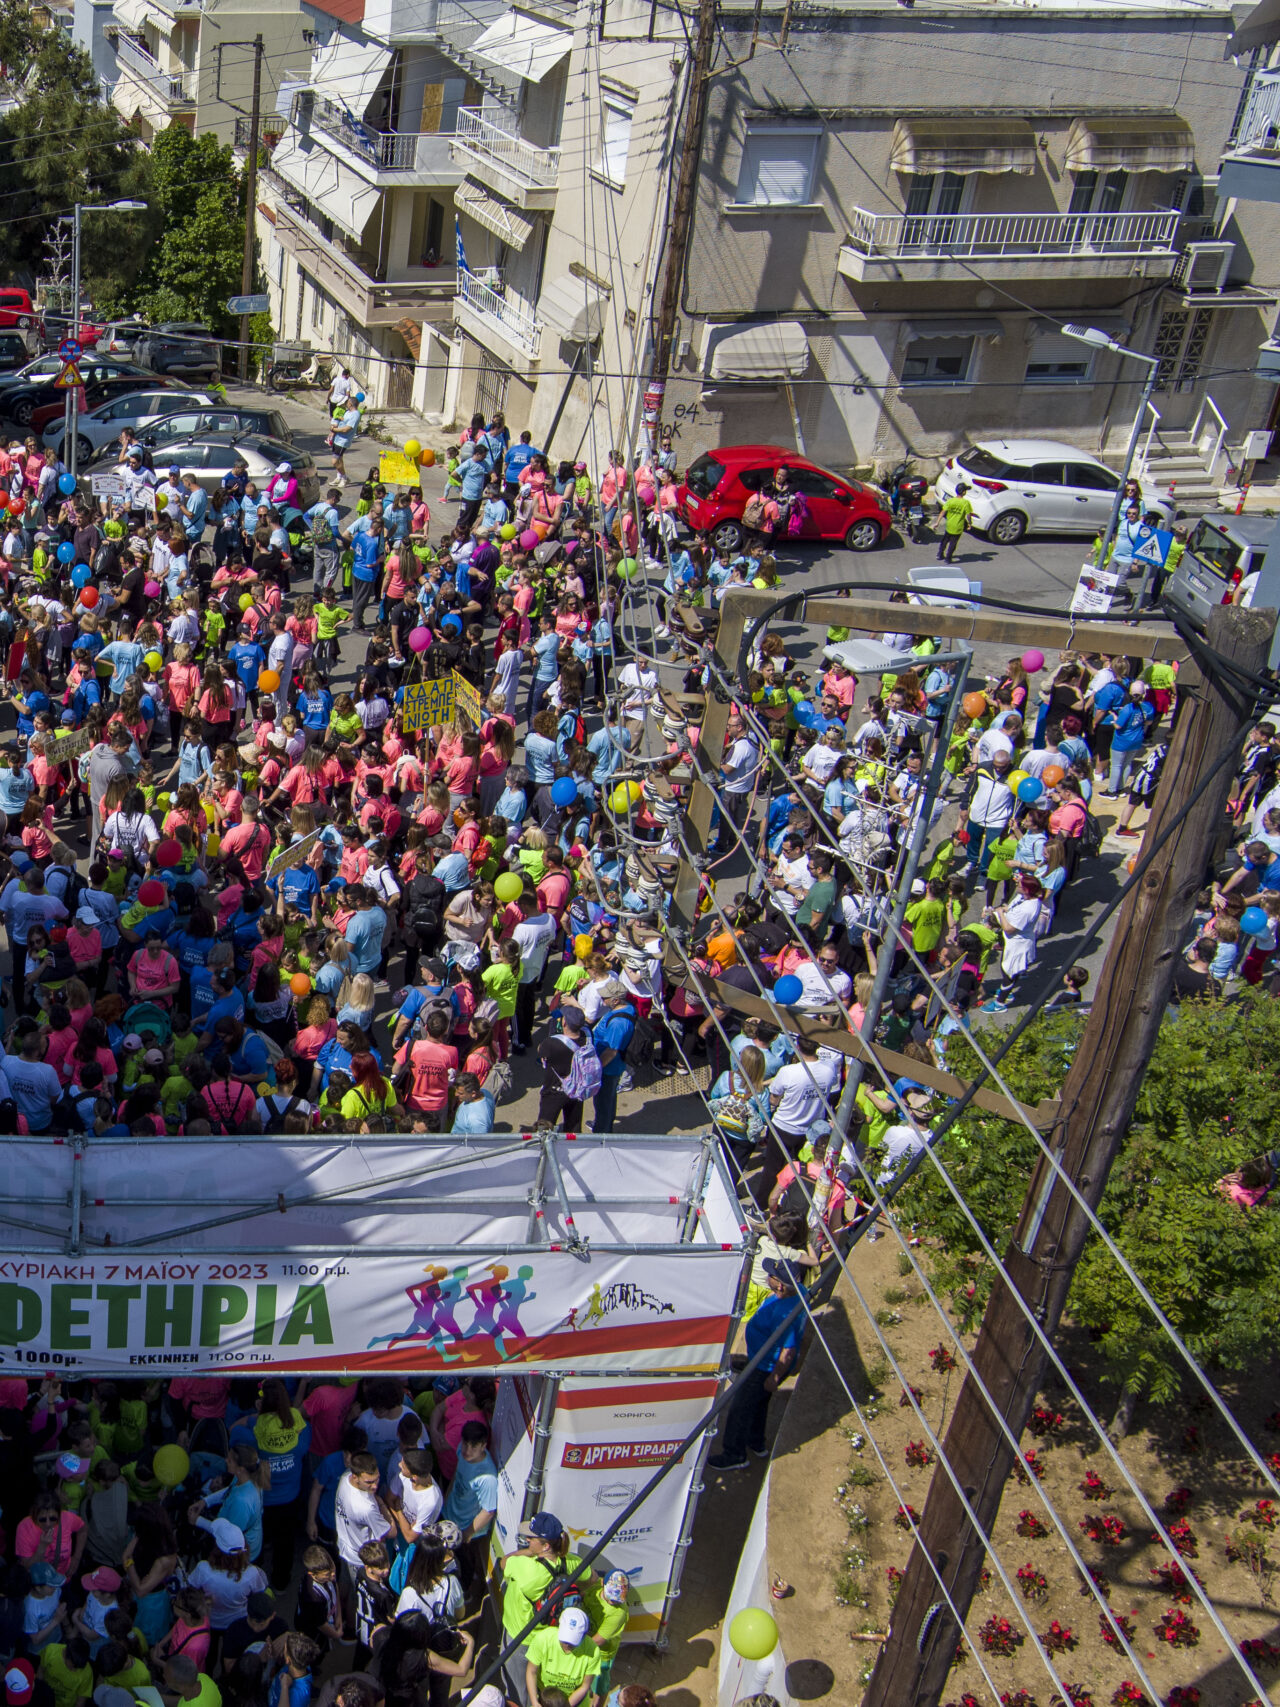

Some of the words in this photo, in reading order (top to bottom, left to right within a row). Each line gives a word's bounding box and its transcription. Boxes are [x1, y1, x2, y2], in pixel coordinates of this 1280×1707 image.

[406, 679, 454, 700] ΚΔΑΠ
[404, 693, 453, 713] ΣΤΡΕΜΠΕ
[104, 1265, 119, 1280] 7
[125, 1260, 200, 1280] ΜΑΪΟΥ
[208, 1263, 269, 1280] 2023
[281, 1264, 319, 1277] 11.00
[14, 1349, 83, 1367] 1000μ.
[129, 1352, 199, 1365] ΕΚΚΙΝΗΣΗ
[208, 1352, 246, 1363] 11.00
[582, 1445, 631, 1466] ΑΡΓΥΡΗ
[632, 1442, 683, 1457] ΣΙΡΔΑΡΗ
[588, 1526, 653, 1536] ΣΚΛΩΣΙΕΣ
[609, 1535, 639, 1543] ΣΤΗΡ
